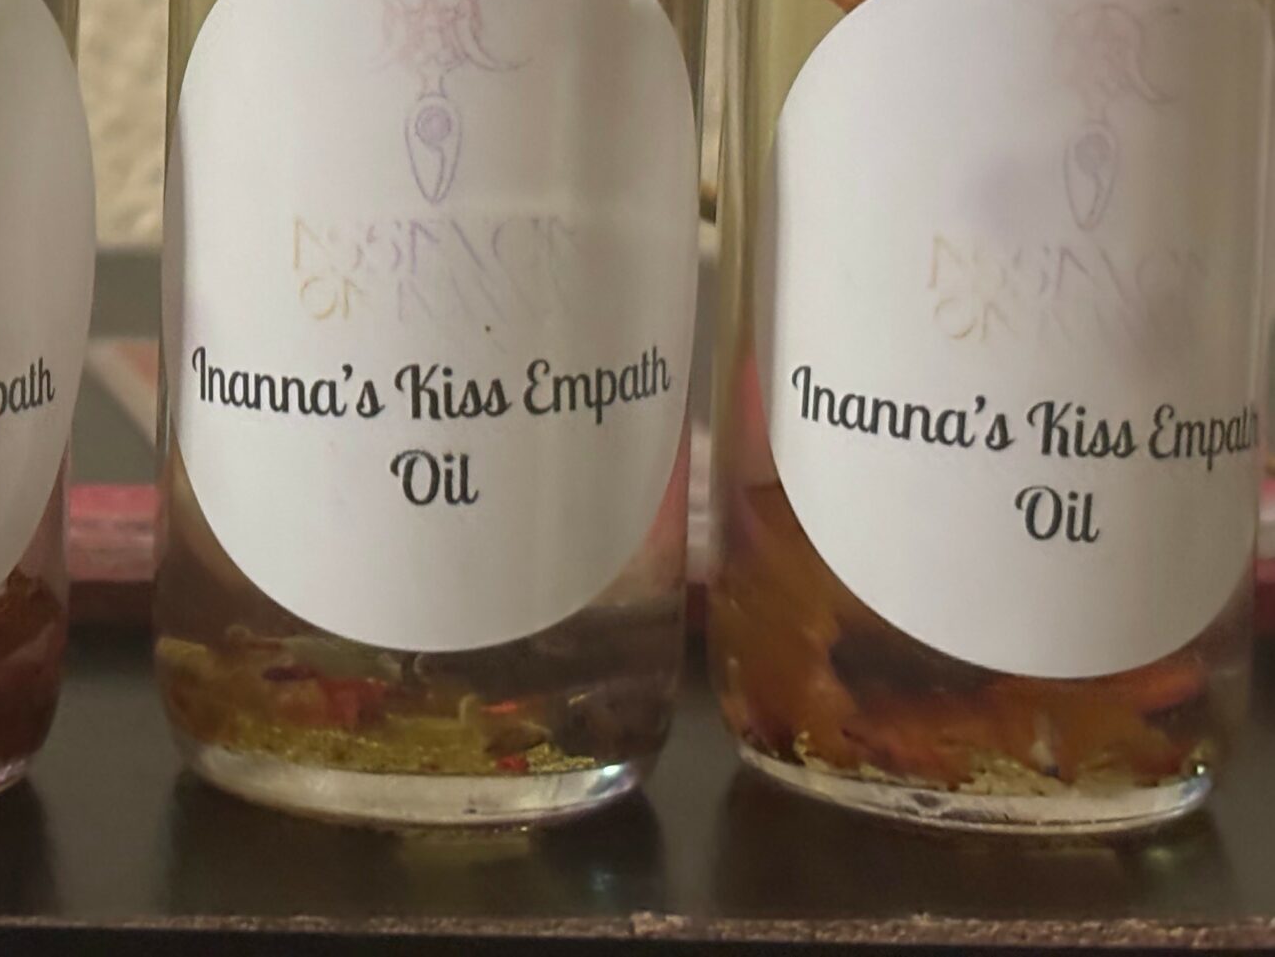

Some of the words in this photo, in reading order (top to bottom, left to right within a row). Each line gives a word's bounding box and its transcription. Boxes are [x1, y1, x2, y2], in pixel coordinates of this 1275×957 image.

[191, 345, 387, 420] Inanna's
[393, 363, 513, 422] Kiss
[522, 346, 671, 426] Empath
[791, 364, 1016, 453] Inanna's
[1026, 400, 1138, 459] Kiss
[389, 448, 480, 507] Oil
[1014, 485, 1101, 544] Oil
